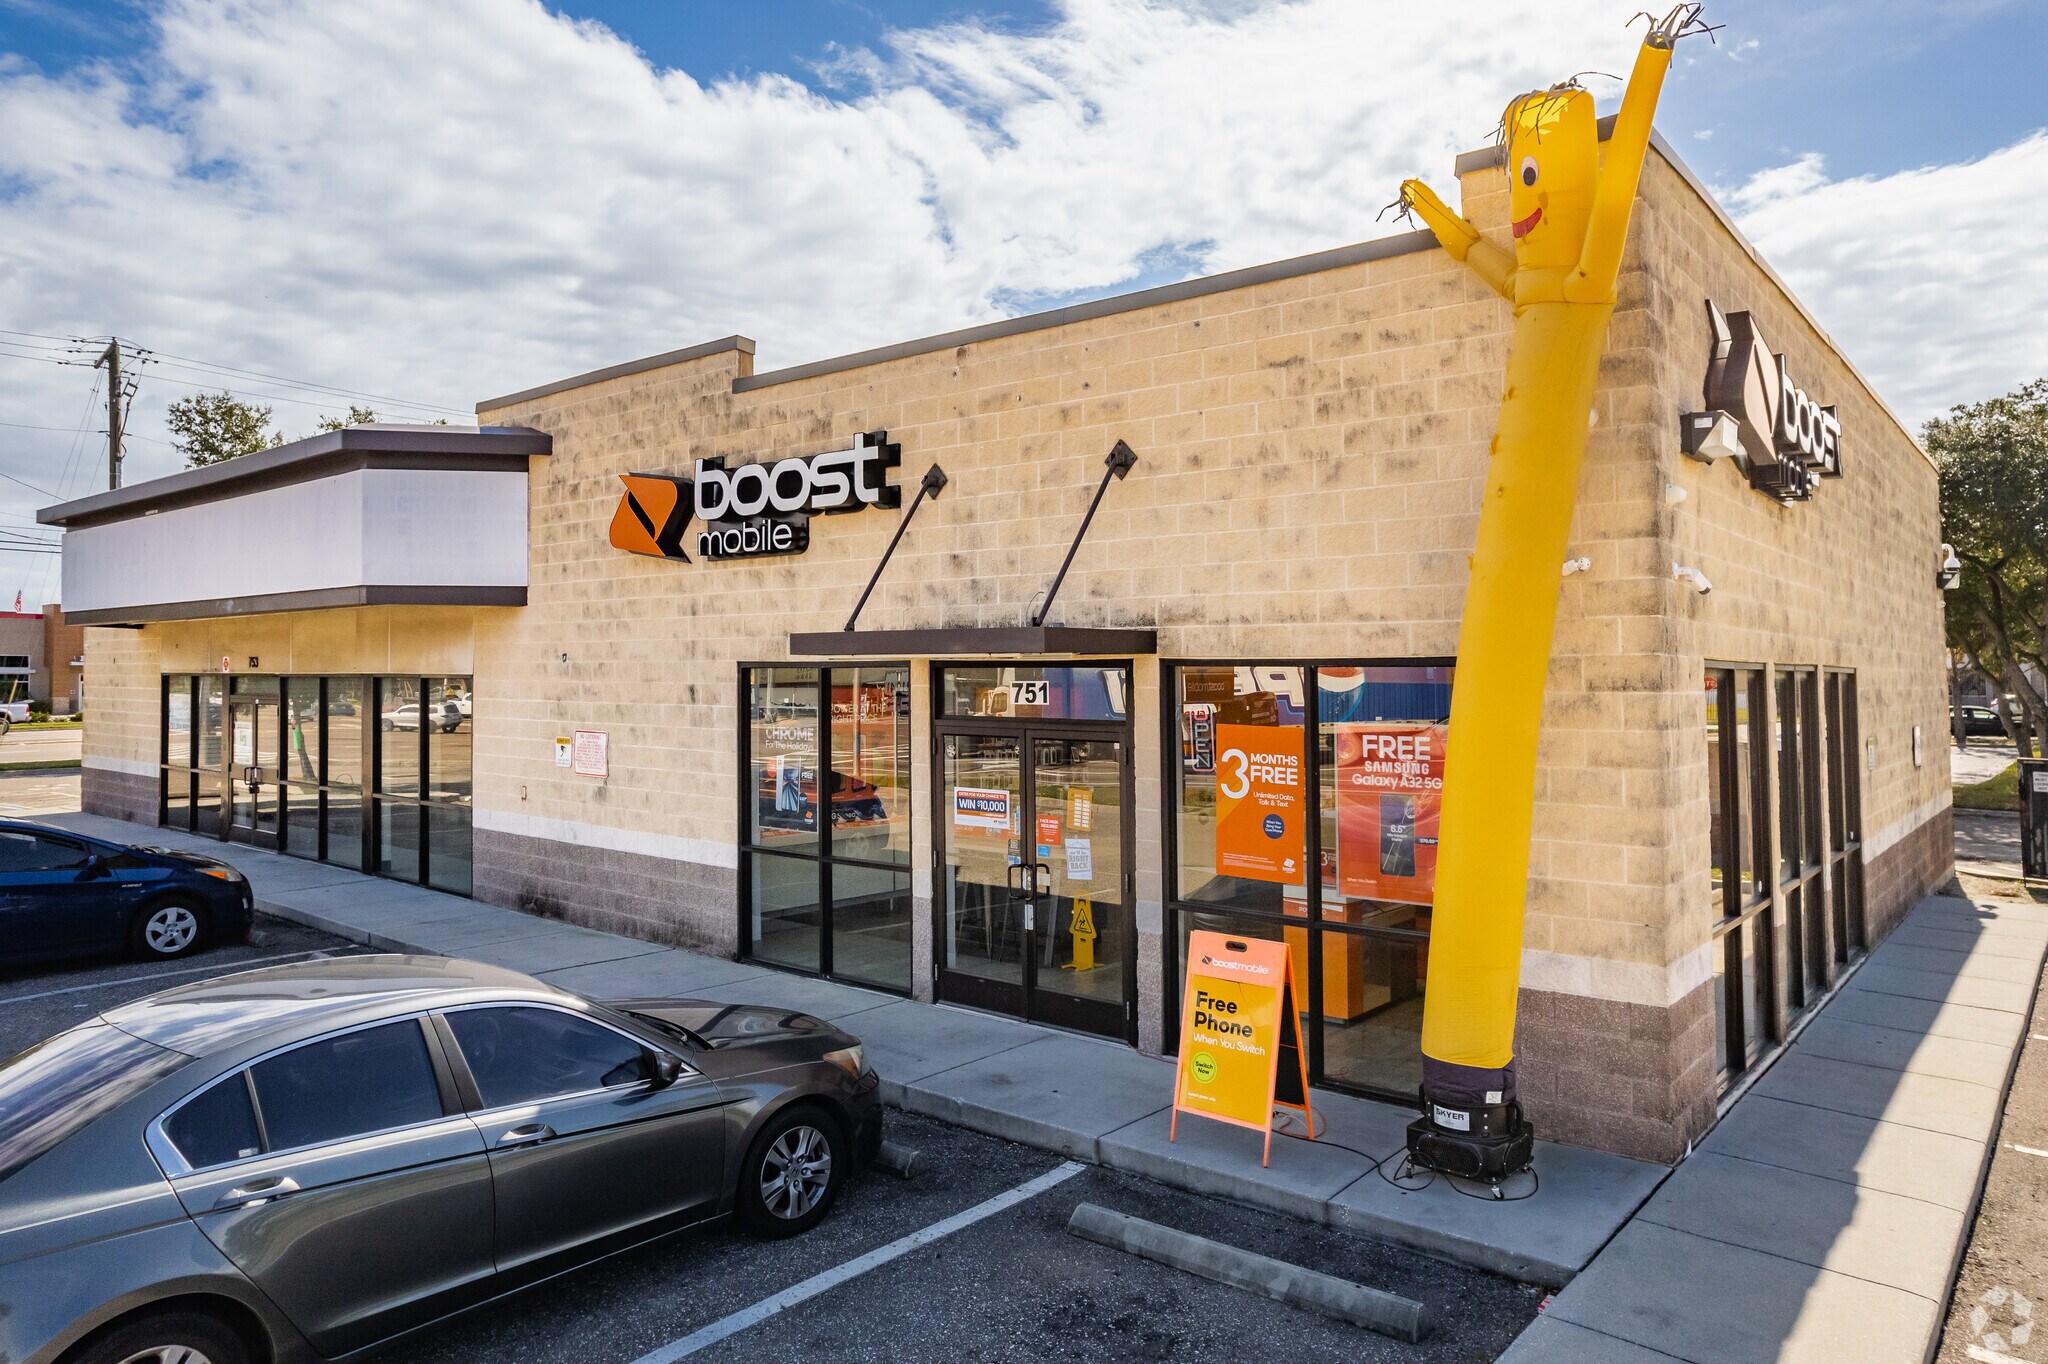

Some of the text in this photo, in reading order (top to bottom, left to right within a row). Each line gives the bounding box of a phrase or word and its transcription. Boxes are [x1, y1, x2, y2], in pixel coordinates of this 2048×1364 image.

[694, 431, 880, 521] boost
[698, 519, 793, 556] mobile
[248, 656, 259, 668] 753
[1011, 682, 1048, 704] 751
[765, 728, 814, 742] CHROME
[1193, 711, 1211, 768] OPEN
[765, 740, 814, 752] For The Holidays
[1362, 734, 1431, 760] FREE
[1250, 753, 1298, 766] MONTHS
[1364, 760, 1430, 775] SAMSUNG
[1220, 748, 1250, 799] 3
[1250, 765, 1298, 786] FREE
[1352, 773, 1442, 790] Galaxy A32 5G
[1253, 791, 1278, 800] Unlimited
[958, 798, 1005, 812] WIN $10,000
[1068, 855, 1089, 863] RIGHT
[1070, 862, 1088, 870] BACK
[1211, 958, 1269, 975] boostmobile
[1196, 990, 1238, 1014] Free
[1194, 1010, 1253, 1038] Phone
[1193, 1033, 1265, 1056] When You Switch
[1195, 1060, 1214, 1070] Switch
[1436, 1108, 1465, 1120] SKYER
